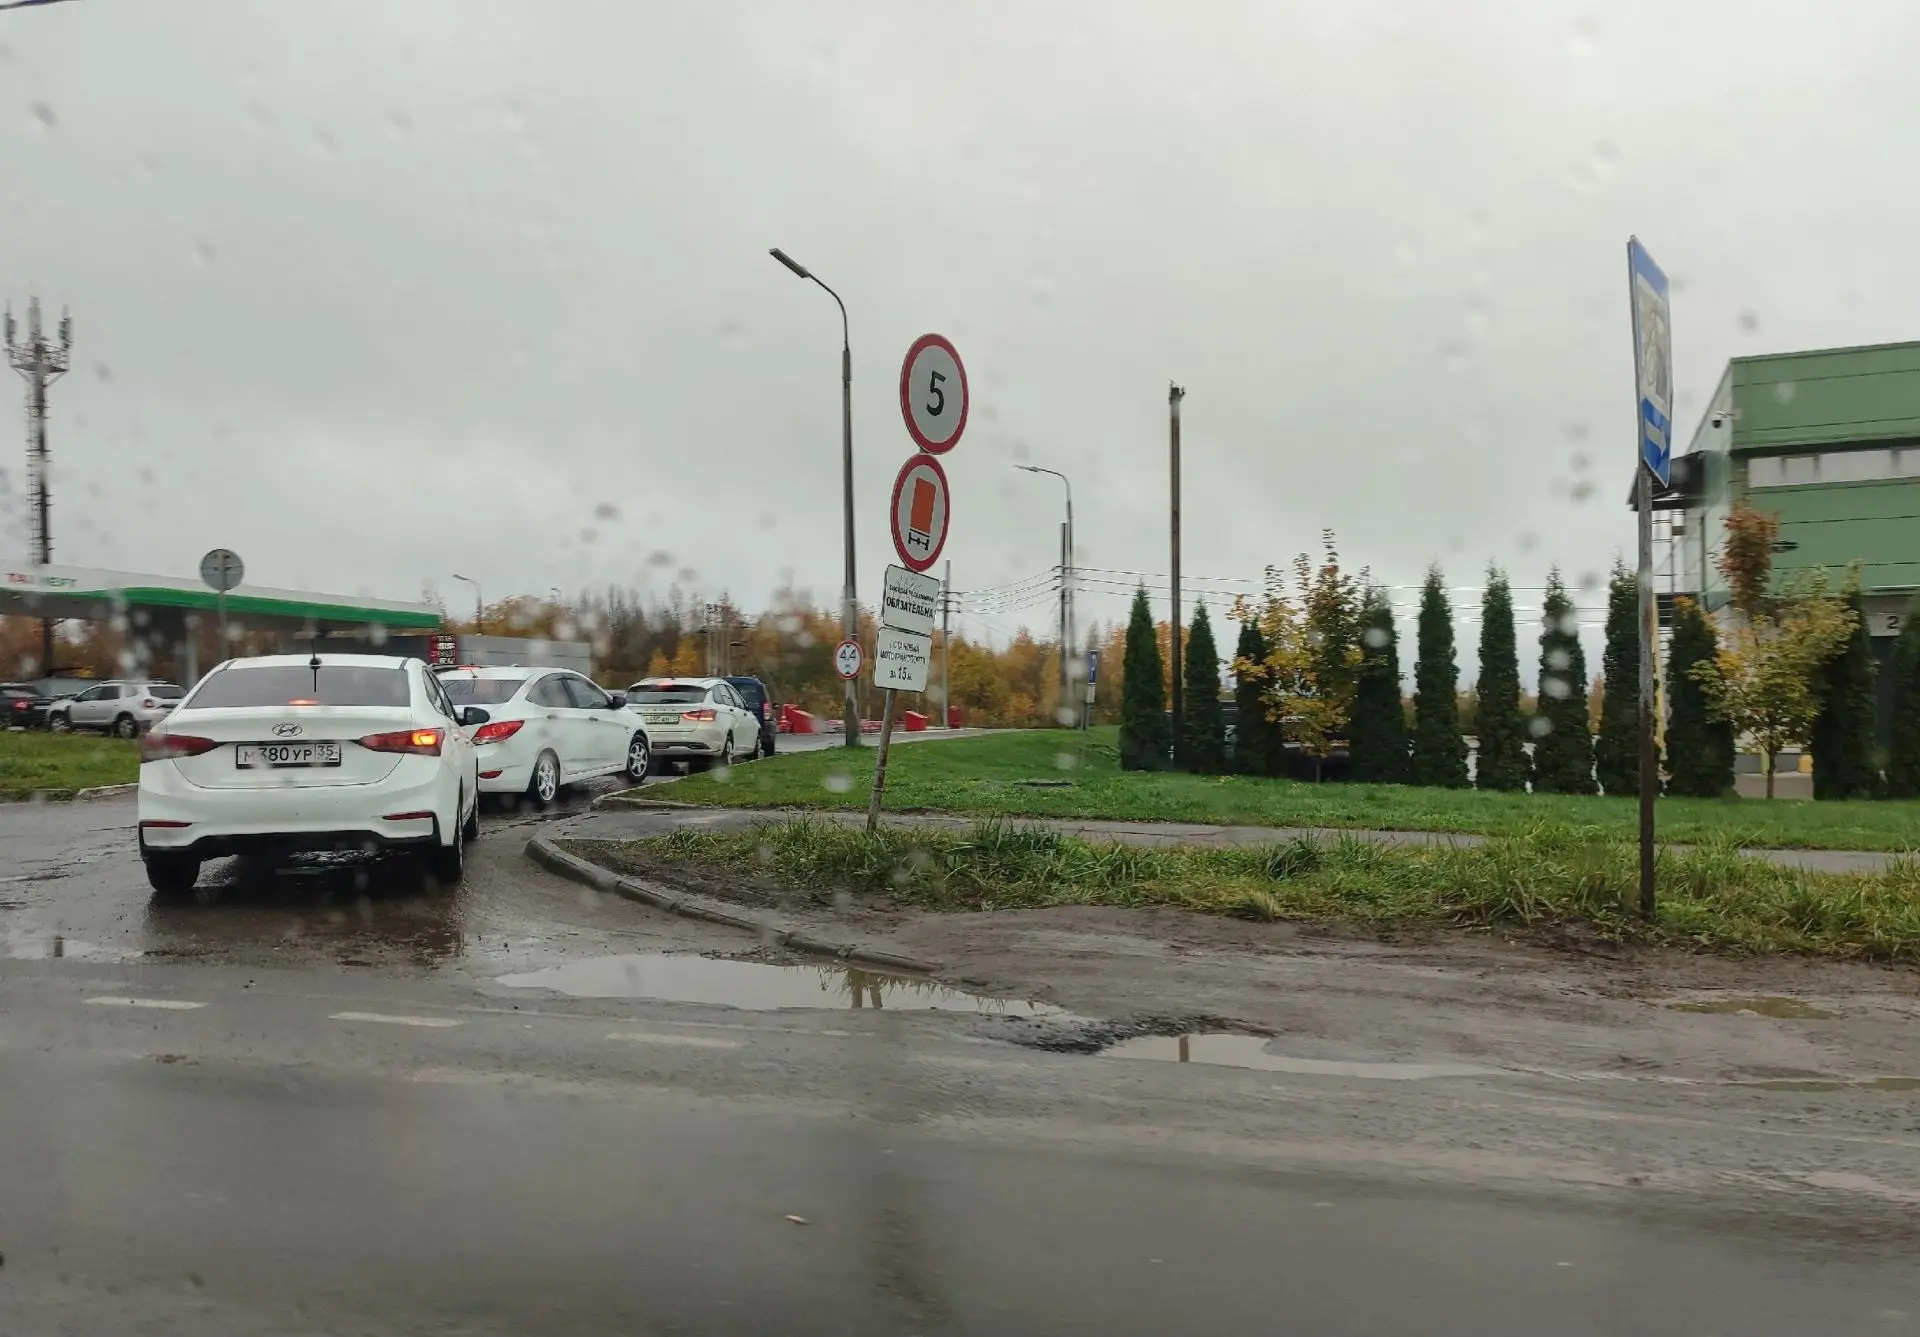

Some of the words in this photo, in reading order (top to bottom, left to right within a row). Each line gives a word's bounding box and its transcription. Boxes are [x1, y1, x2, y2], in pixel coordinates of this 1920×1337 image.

[926, 370, 946, 416] 5
[886, 596, 933, 618] ОБЯЗАТЕЛЬНА
[1887, 615, 1899, 629] 2
